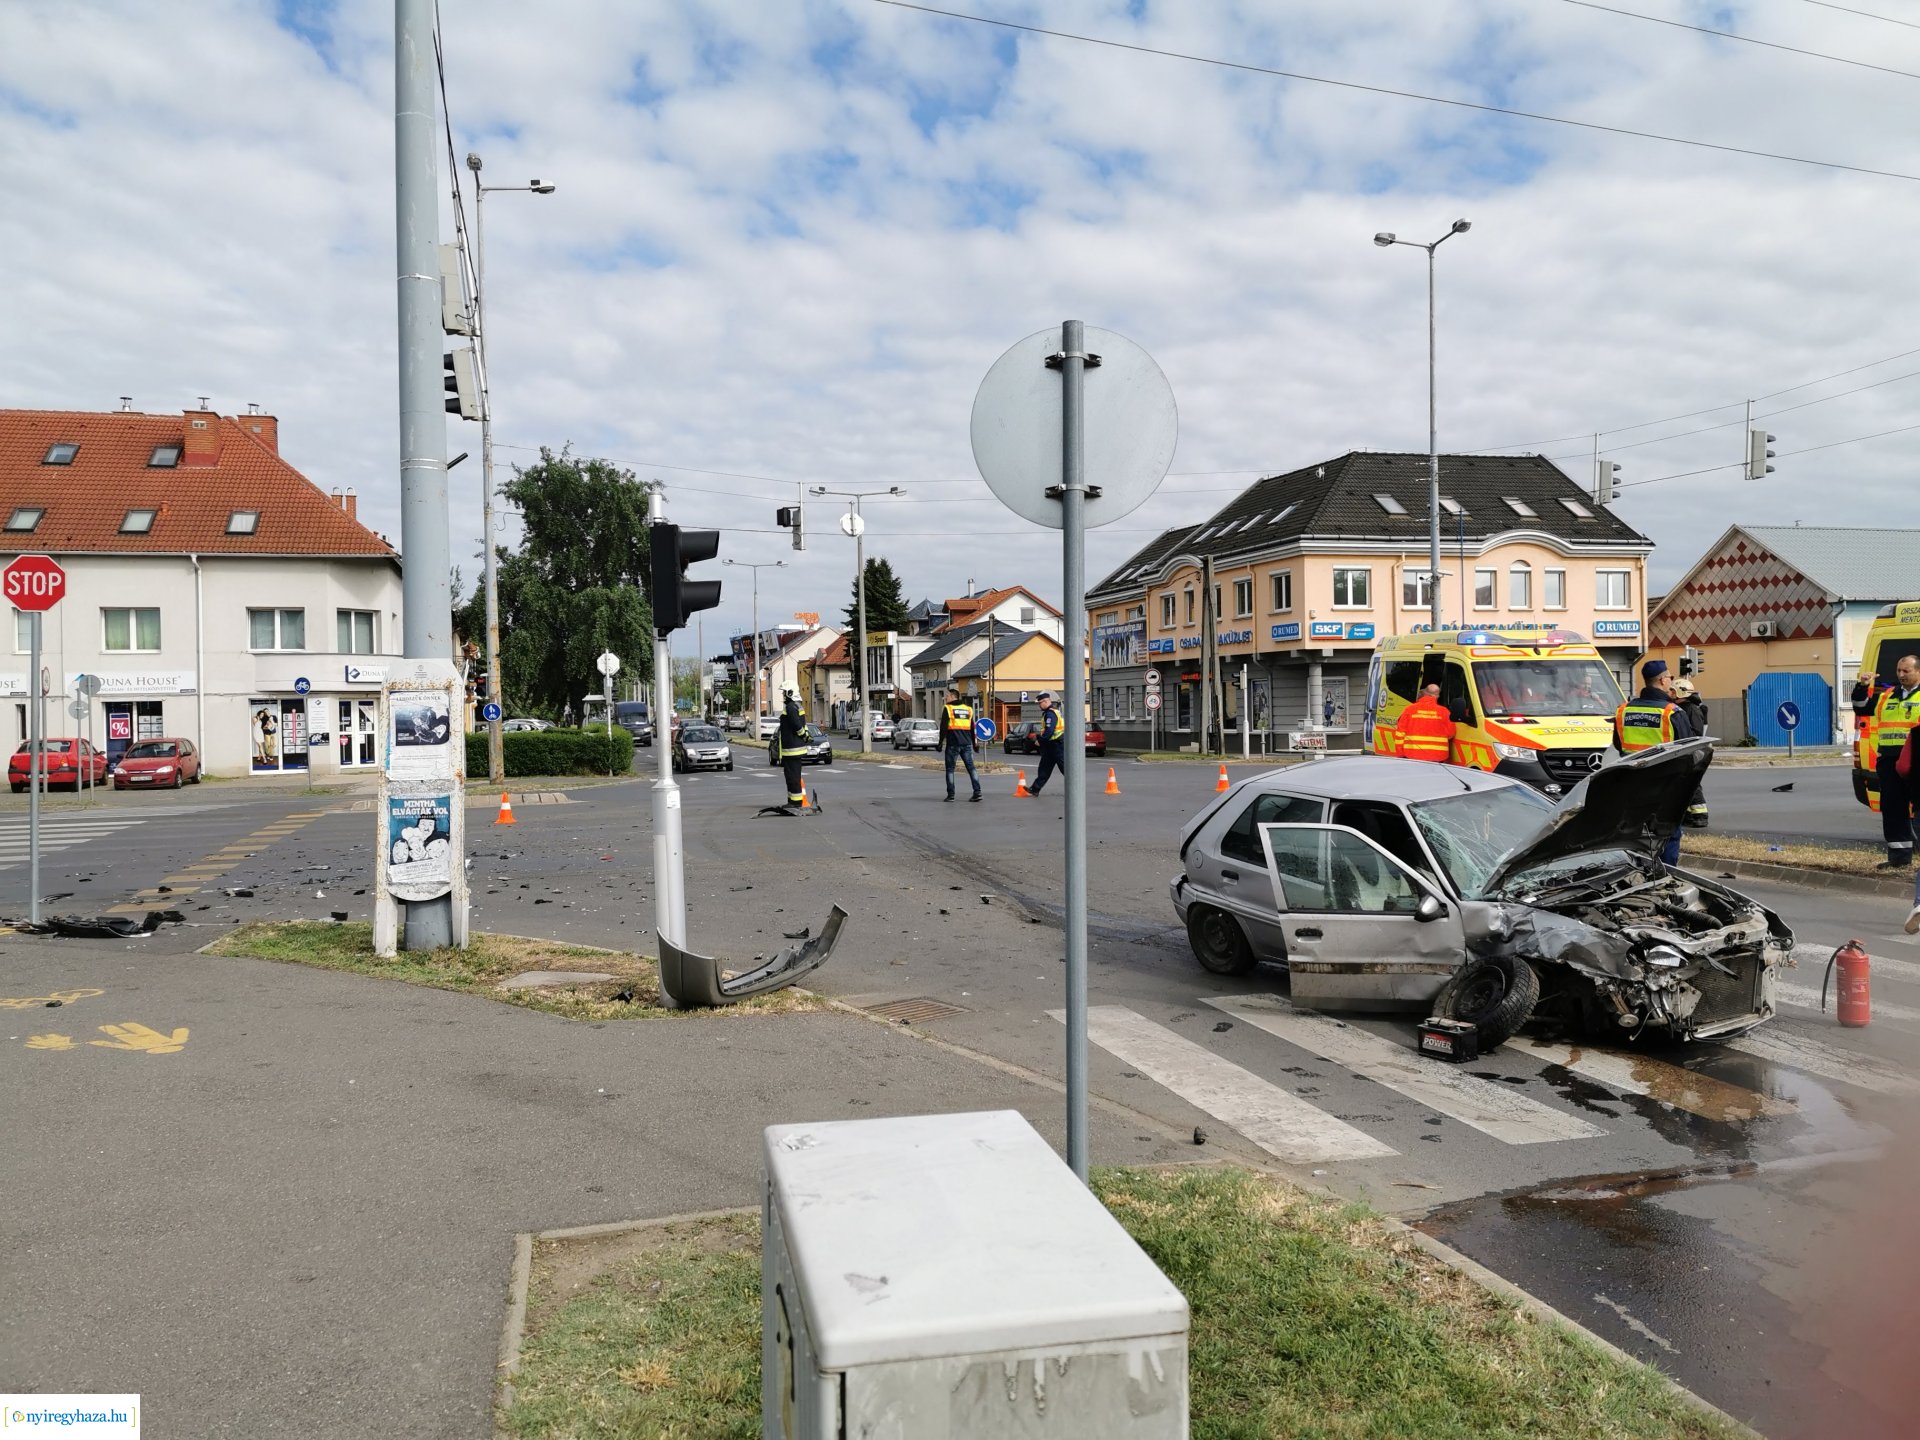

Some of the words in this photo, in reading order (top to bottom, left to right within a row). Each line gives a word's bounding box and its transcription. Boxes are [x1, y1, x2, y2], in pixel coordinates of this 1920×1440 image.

[7, 571, 62, 596] STOP
[1315, 624, 1341, 633] SKF
[1606, 622, 1640, 632] RUMED
[136, 677, 178, 686] HOUSE
[392, 807, 431, 816] ELVÁGTÁK
[1423, 1037, 1452, 1050] POWER
